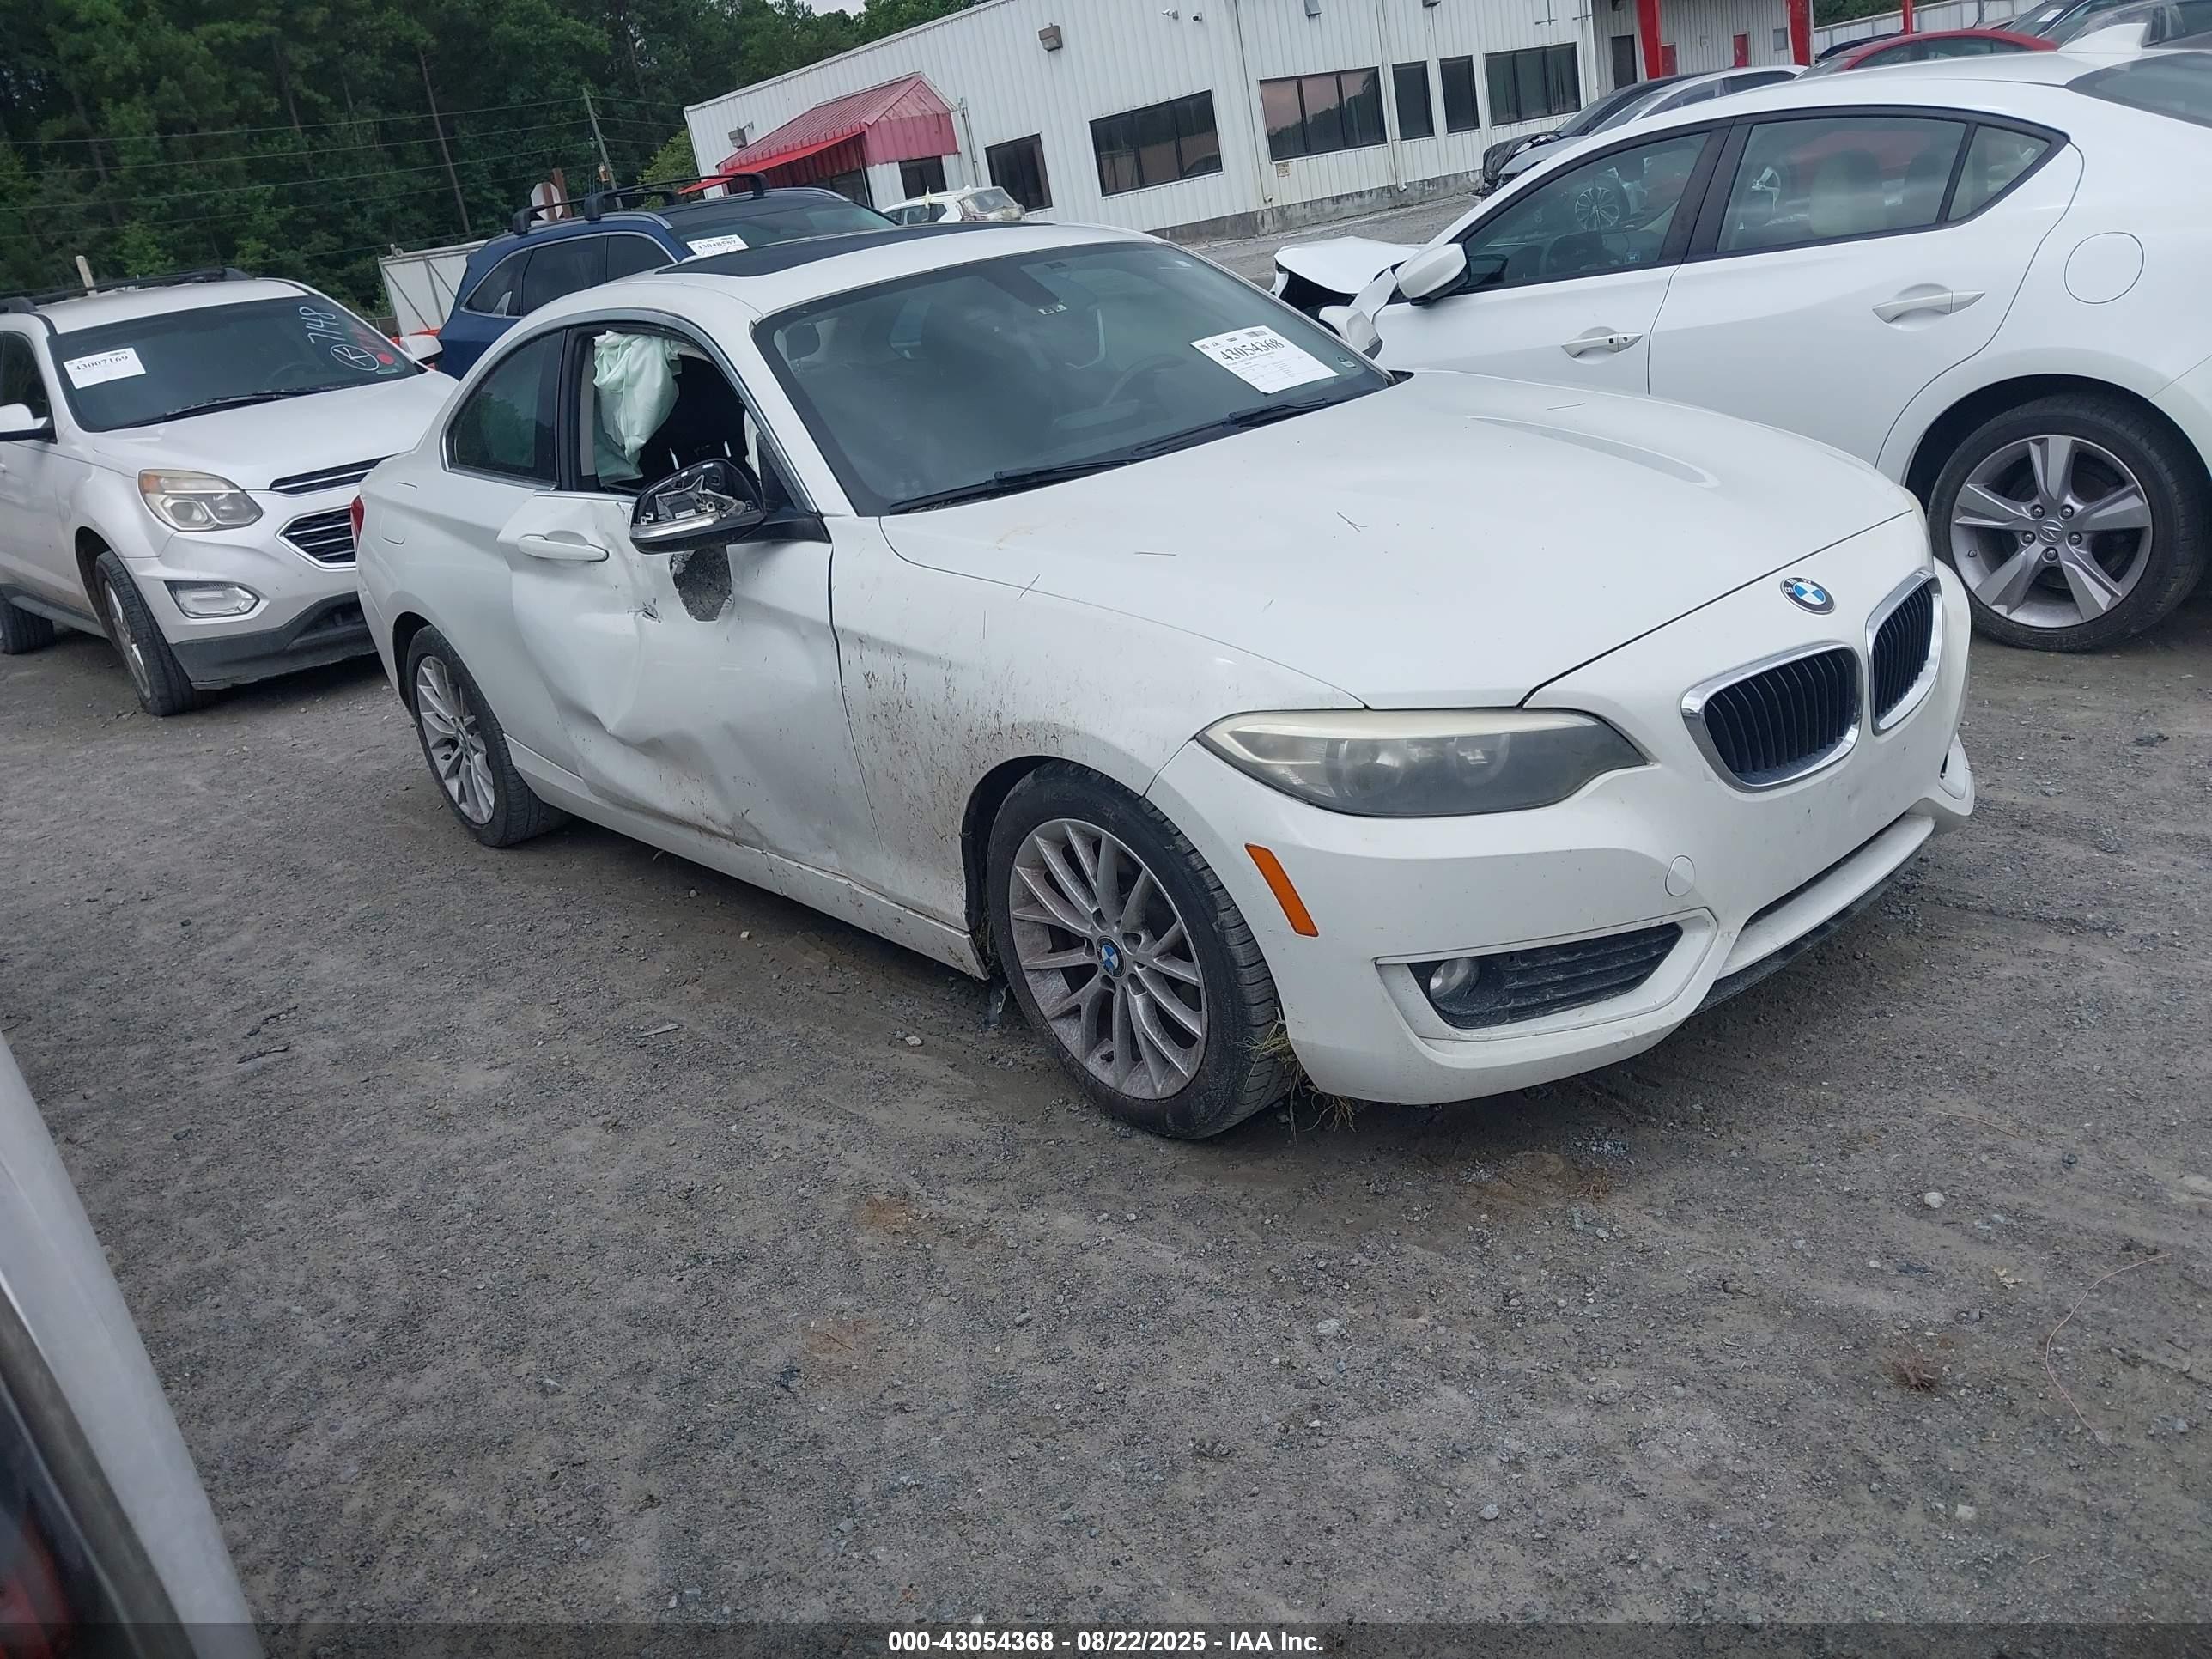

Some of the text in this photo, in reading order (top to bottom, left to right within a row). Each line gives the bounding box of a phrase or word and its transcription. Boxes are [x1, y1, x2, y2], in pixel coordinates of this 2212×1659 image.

[298, 306, 346, 344] 7148
[1219, 337, 1285, 362] 43054368
[75, 354, 129, 371] 43007169
